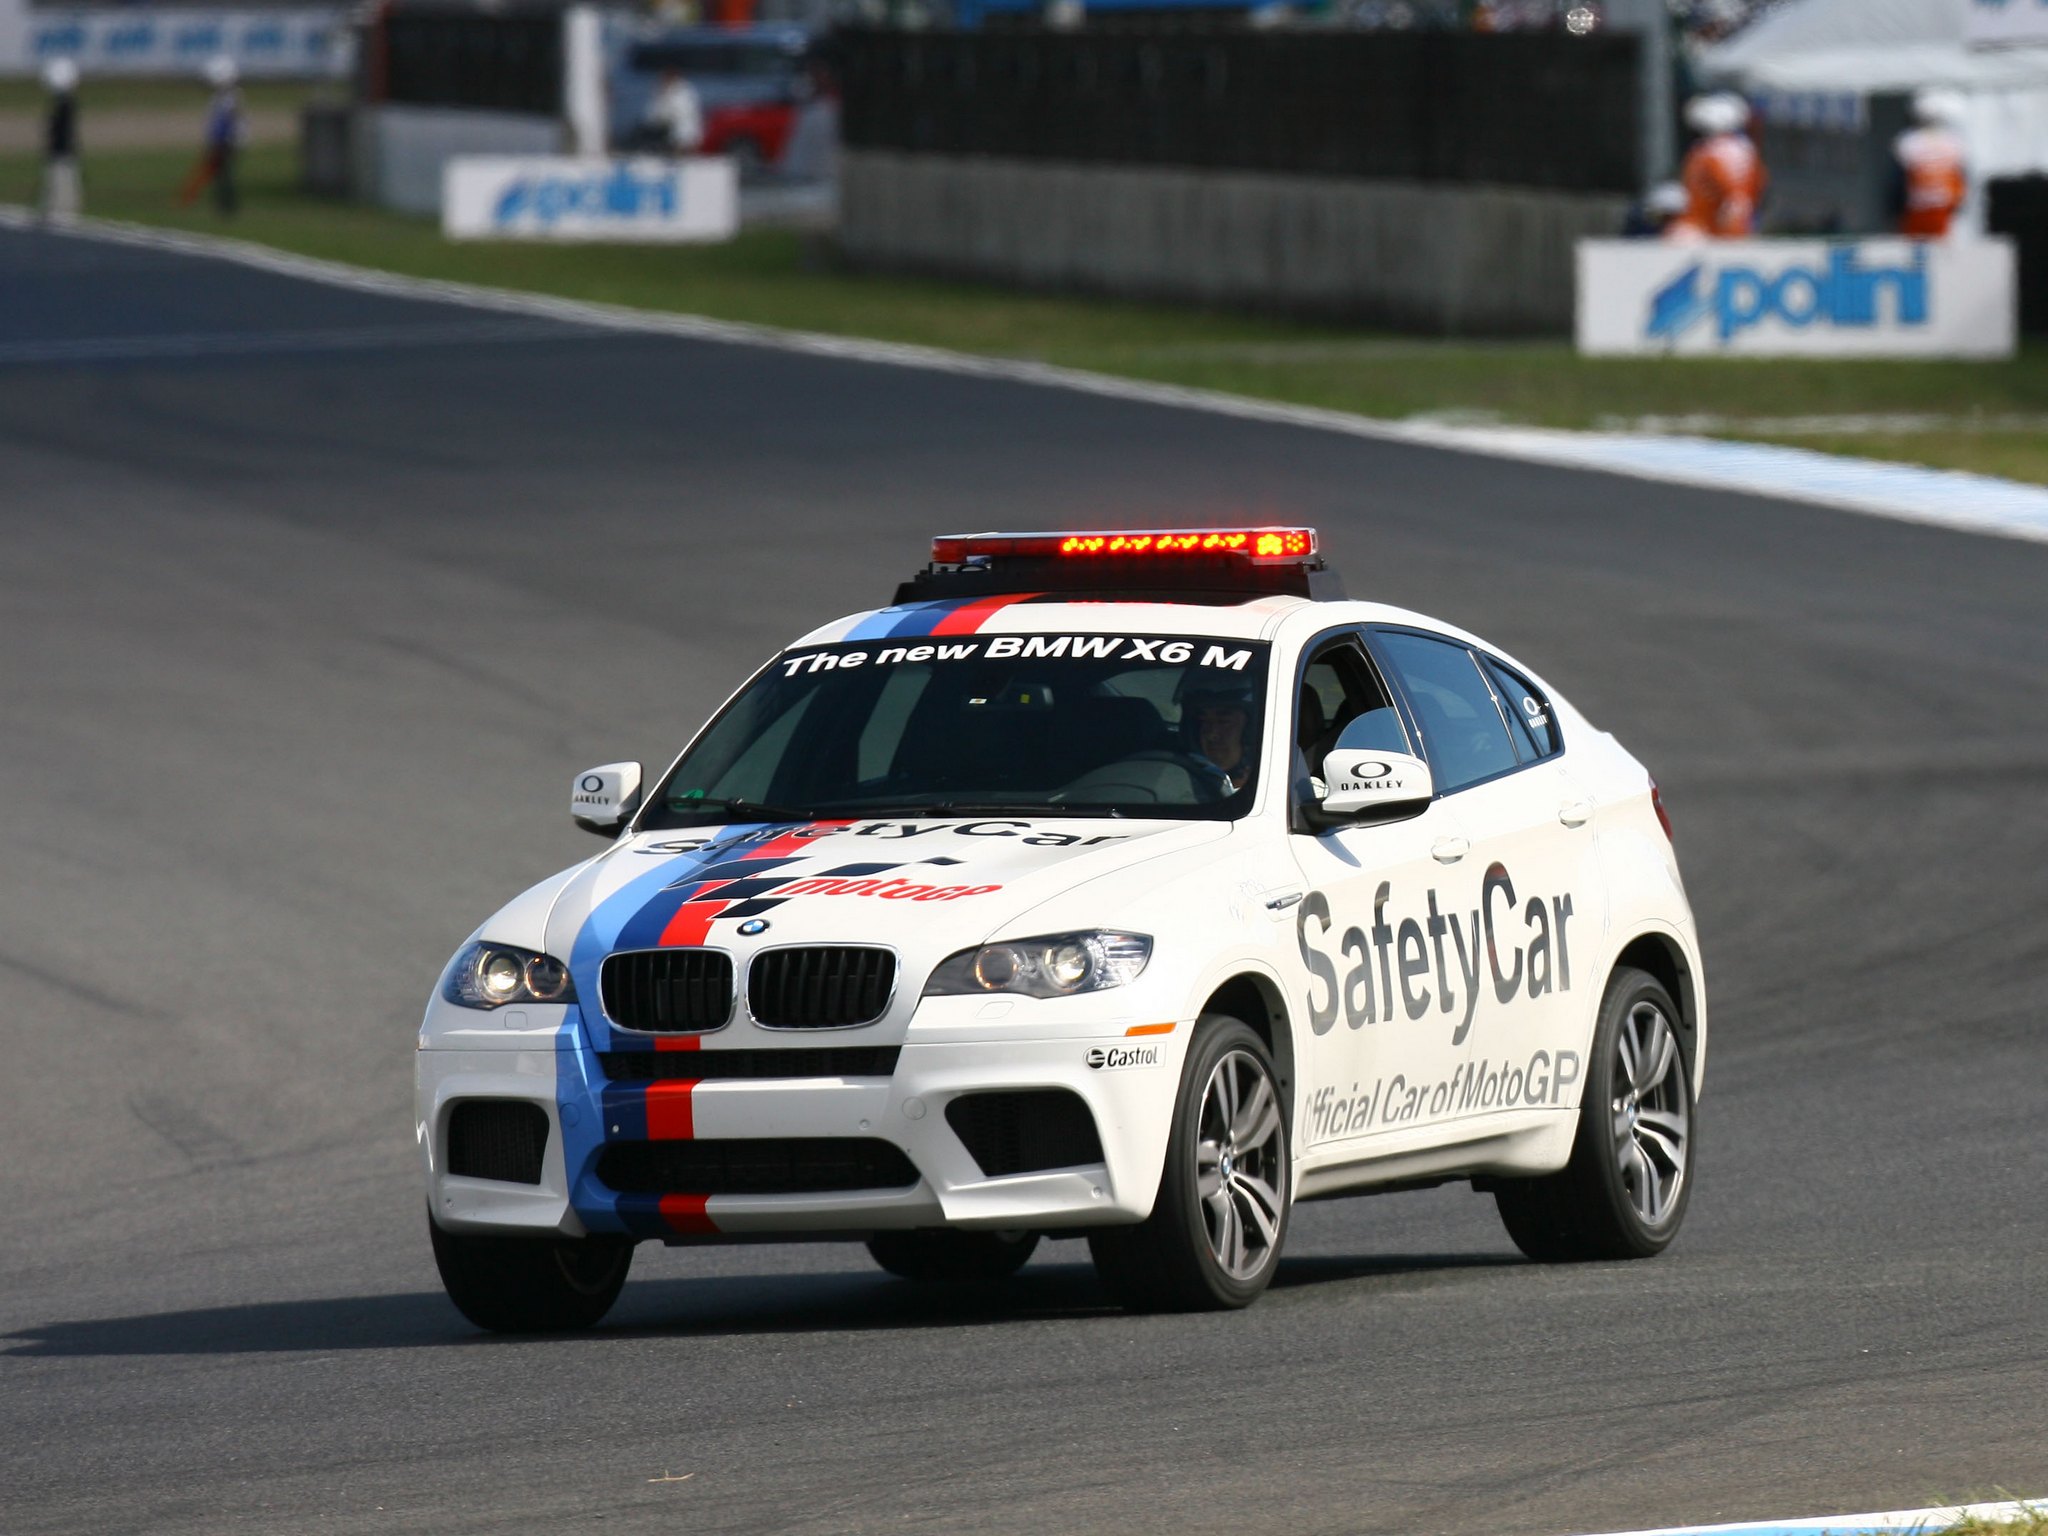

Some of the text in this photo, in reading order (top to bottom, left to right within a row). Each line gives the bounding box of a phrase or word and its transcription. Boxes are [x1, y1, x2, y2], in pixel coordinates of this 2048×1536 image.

[1716, 243, 1929, 342] polini
[782, 636, 1253, 677] The new BMW X6 M
[1340, 779, 1404, 792] OAKLEY
[1297, 860, 1574, 1046] SafetyCar
[1107, 1046, 1158, 1068] Castrol
[1381, 1073, 1429, 1124] Car
[1429, 1062, 1463, 1115] of
[1457, 1049, 1580, 1111] MotoGP
